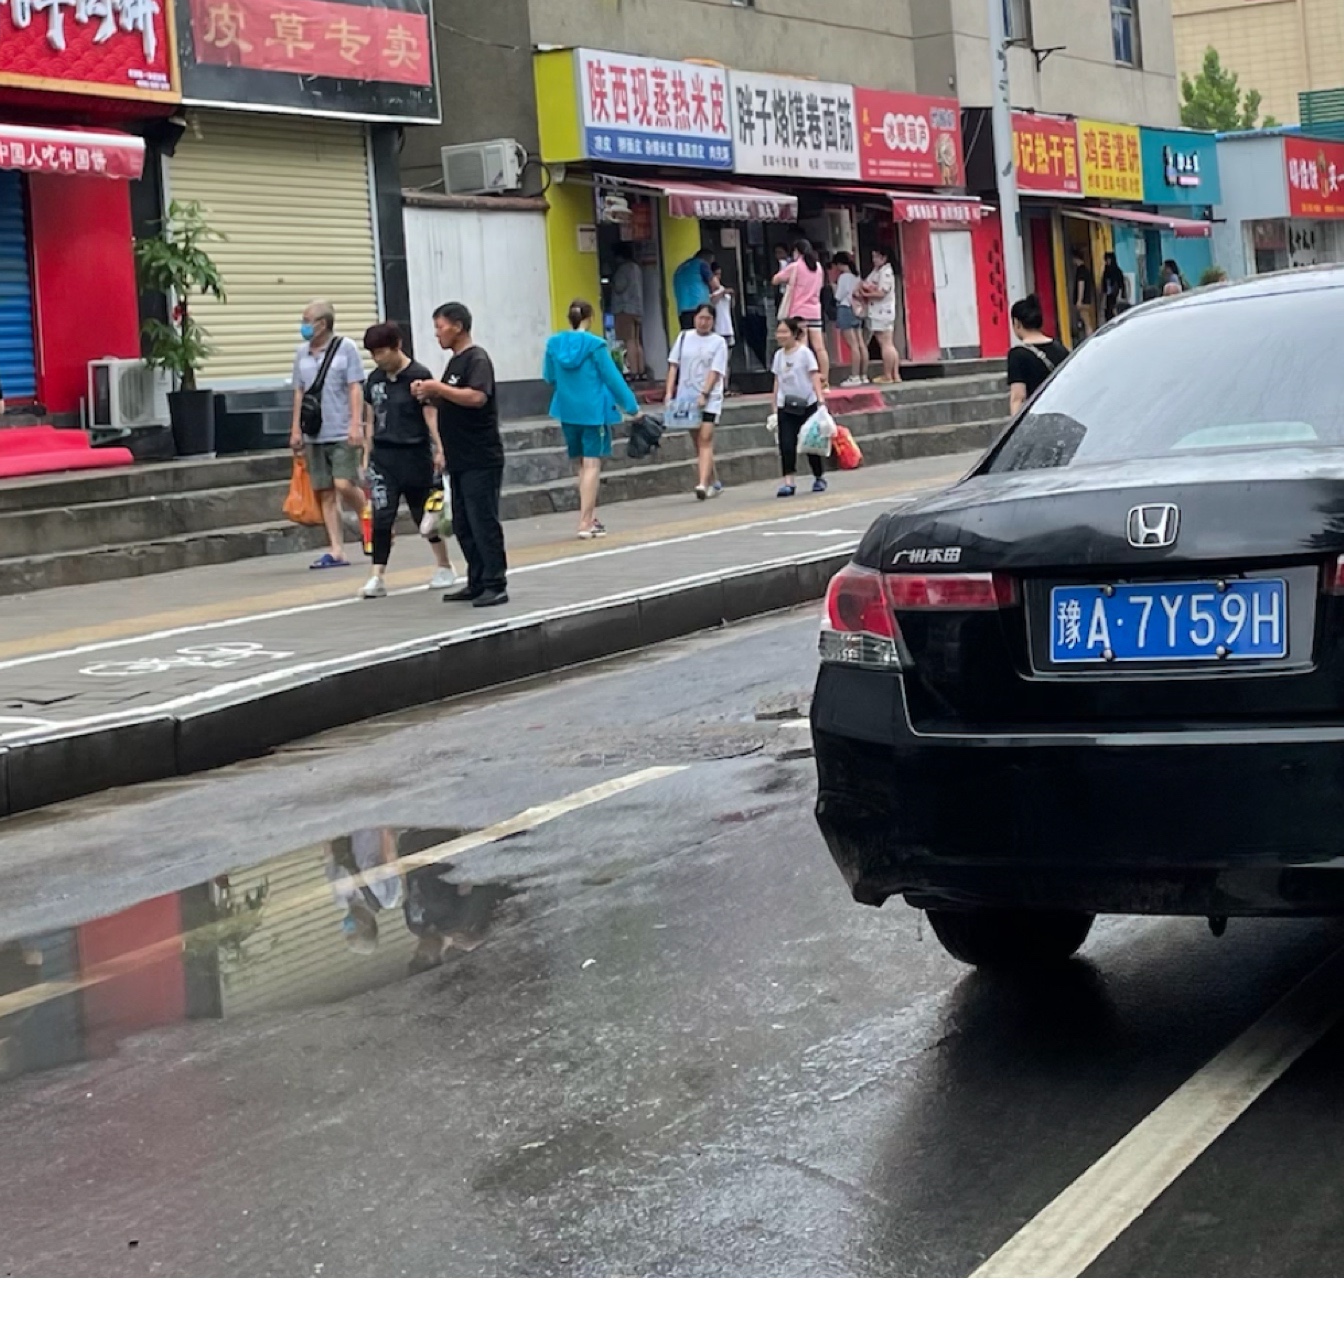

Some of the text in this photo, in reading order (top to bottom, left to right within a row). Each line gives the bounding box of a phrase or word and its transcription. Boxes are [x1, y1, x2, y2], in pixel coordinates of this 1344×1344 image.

[203, 2, 422, 71] 皮草专卖
[587, 59, 728, 135] 陕西现蒸热米皮
[735, 83, 854, 154] 胖子烙馍卷面筋
[1083, 128, 1140, 175] 鸡蛋灌饼
[891, 546, 962, 565] 广州本田
[1056, 591, 1280, 651] 豫A·7Y59H
